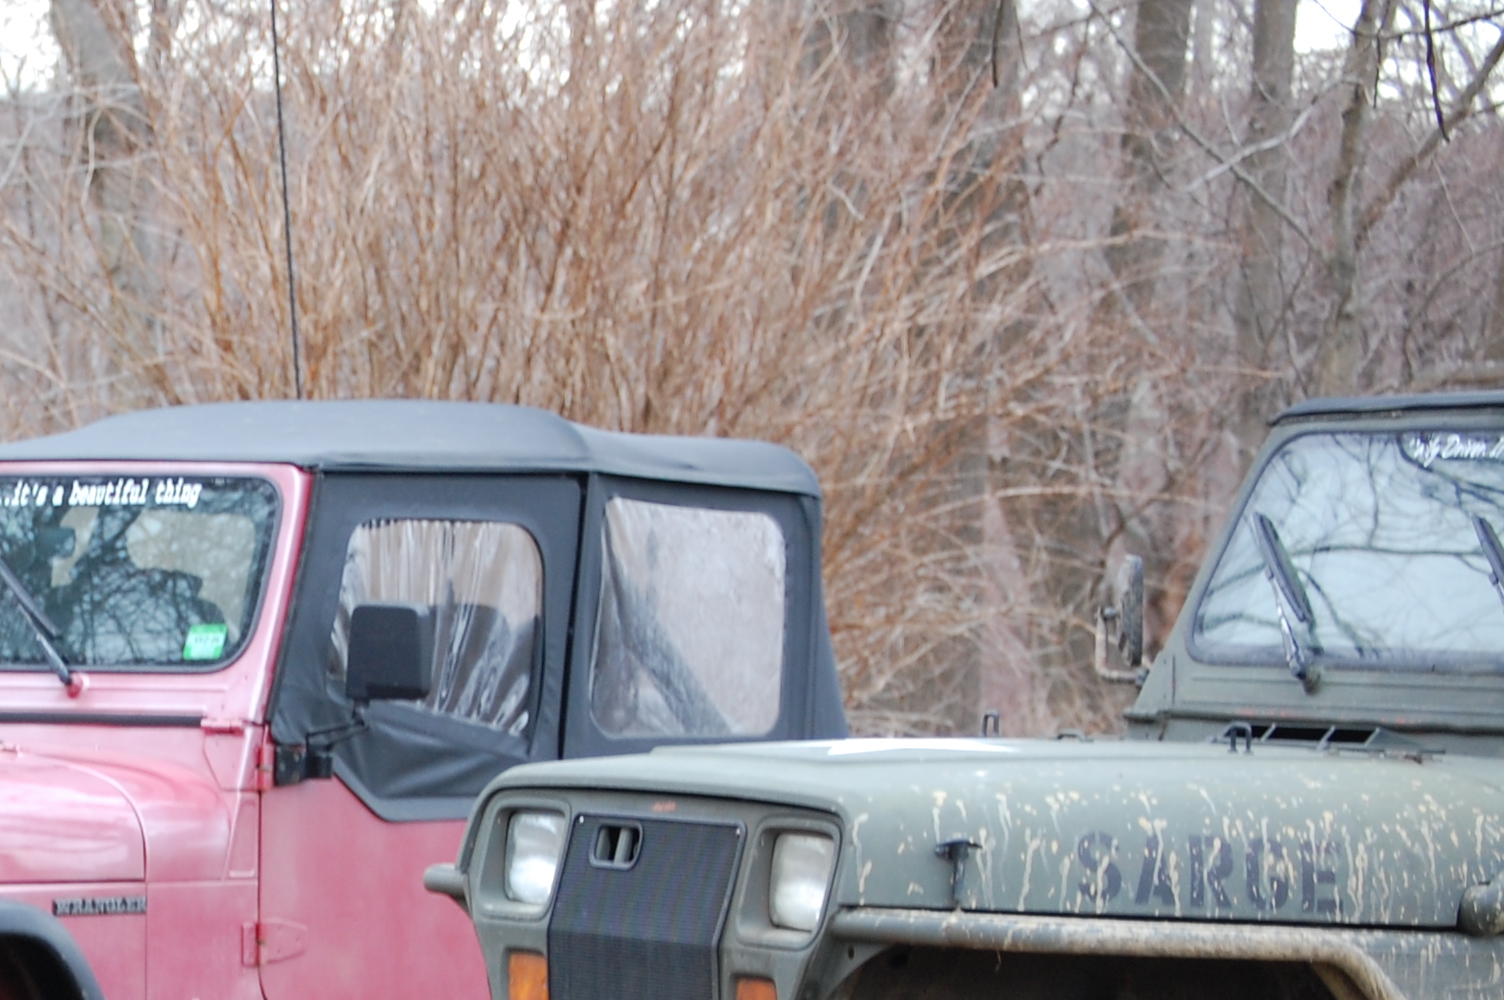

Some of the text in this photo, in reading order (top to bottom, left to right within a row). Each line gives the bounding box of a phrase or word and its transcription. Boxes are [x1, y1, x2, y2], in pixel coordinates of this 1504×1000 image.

[52, 485, 64, 506] a
[68, 478, 149, 506] beautiful
[155, 477, 203, 509] thing
[1078, 831, 1344, 913] SARGE
